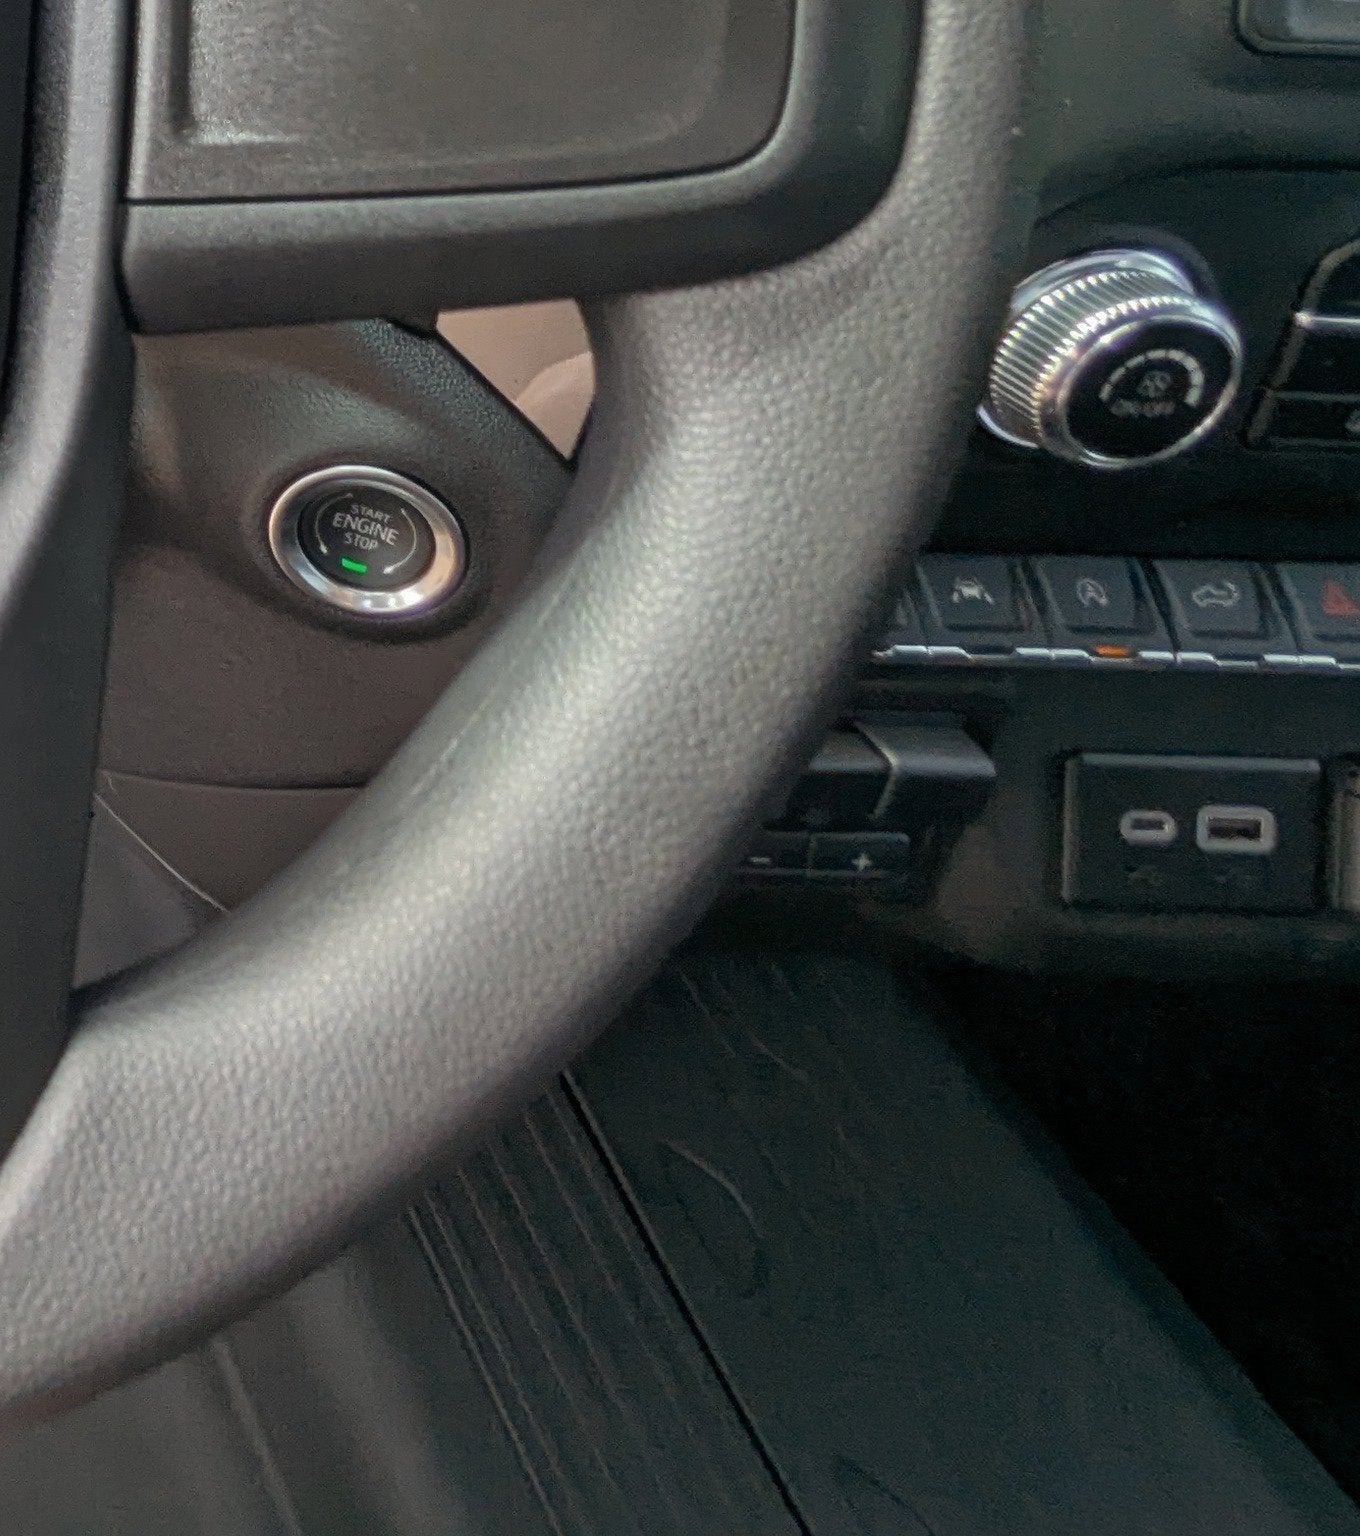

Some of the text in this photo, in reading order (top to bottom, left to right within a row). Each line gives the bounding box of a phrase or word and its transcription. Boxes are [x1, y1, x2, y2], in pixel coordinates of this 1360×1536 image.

[350, 504, 391, 521] START
[332, 514, 399, 546] ENGINE
[344, 532, 378, 550] STOP
